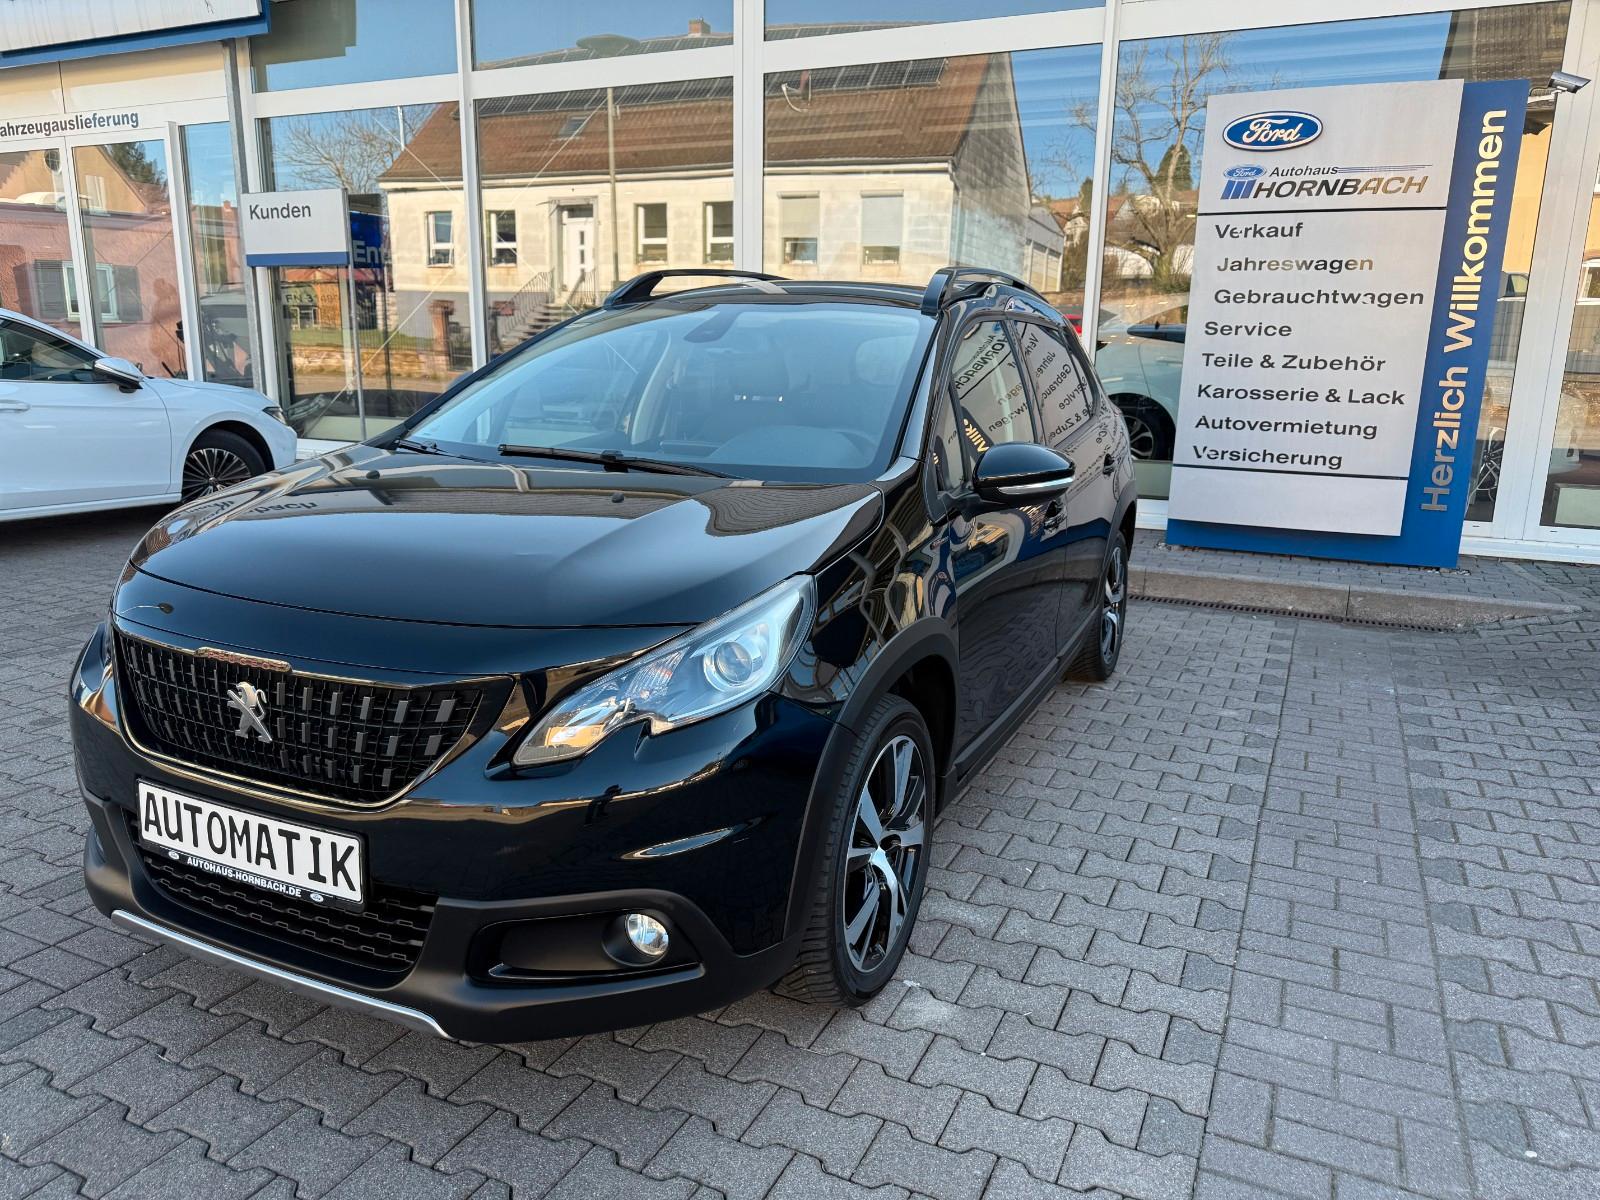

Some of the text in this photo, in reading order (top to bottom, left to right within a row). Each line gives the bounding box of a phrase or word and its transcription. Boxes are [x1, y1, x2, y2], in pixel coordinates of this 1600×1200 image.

[0, 112, 140, 138] ahrzeugauslieferung
[1269, 164, 1340, 178] Autohaus
[1252, 174, 1430, 200] HORNBACH
[249, 202, 312, 221] Kunden
[1215, 222, 1304, 240] Verkauf
[1216, 257, 1374, 275] Jahreswagen
[1214, 288, 1425, 309] Gebrauchtwagen
[1420, 109, 1508, 512] Herzlich Willkommen
[1204, 321, 1293, 338] Service
[1201, 352, 1387, 372] Teile & Zubehör
[1197, 383, 1407, 406] Karosserie & Lack
[1194, 415, 1379, 440] Autovermietung
[1192, 444, 1343, 470] Versicherung
[143, 791, 357, 892] AUTOMATIK
[186, 856, 303, 898] AUTOHAUS-HORNBACH.DE
